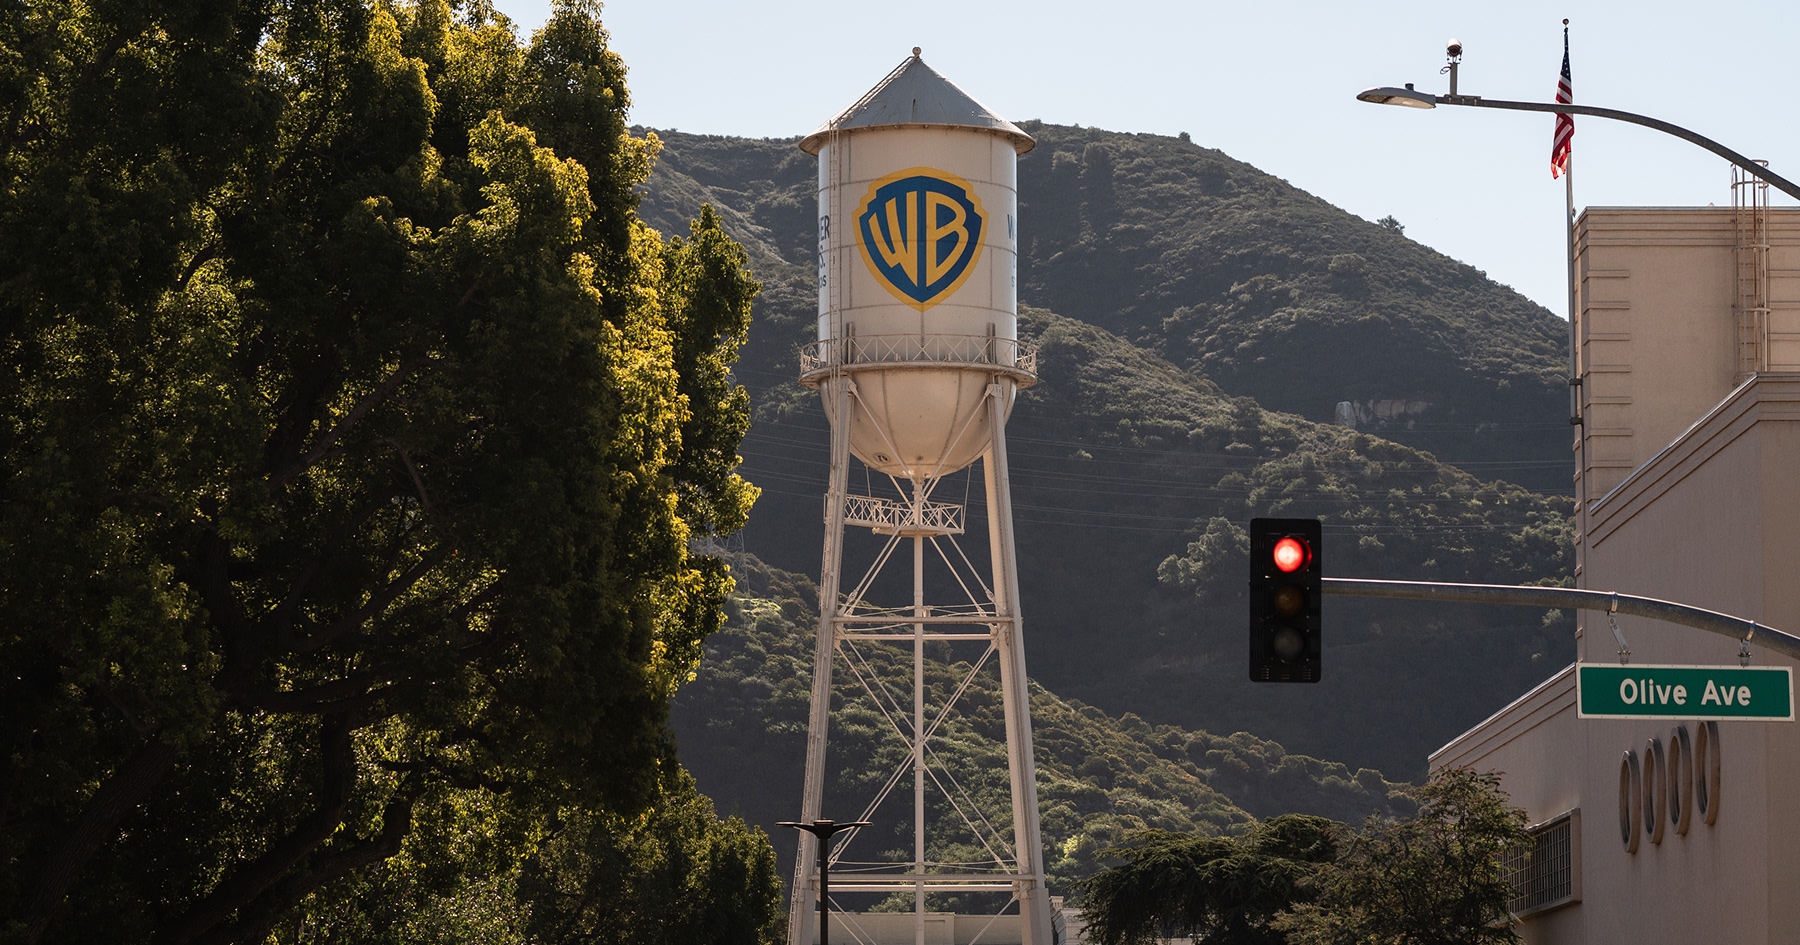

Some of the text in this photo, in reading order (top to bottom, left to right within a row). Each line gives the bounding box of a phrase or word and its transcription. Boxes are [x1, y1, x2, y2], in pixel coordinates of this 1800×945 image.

[868, 190, 969, 287] WB
[1619, 678, 1752, 706] Olive Ave
